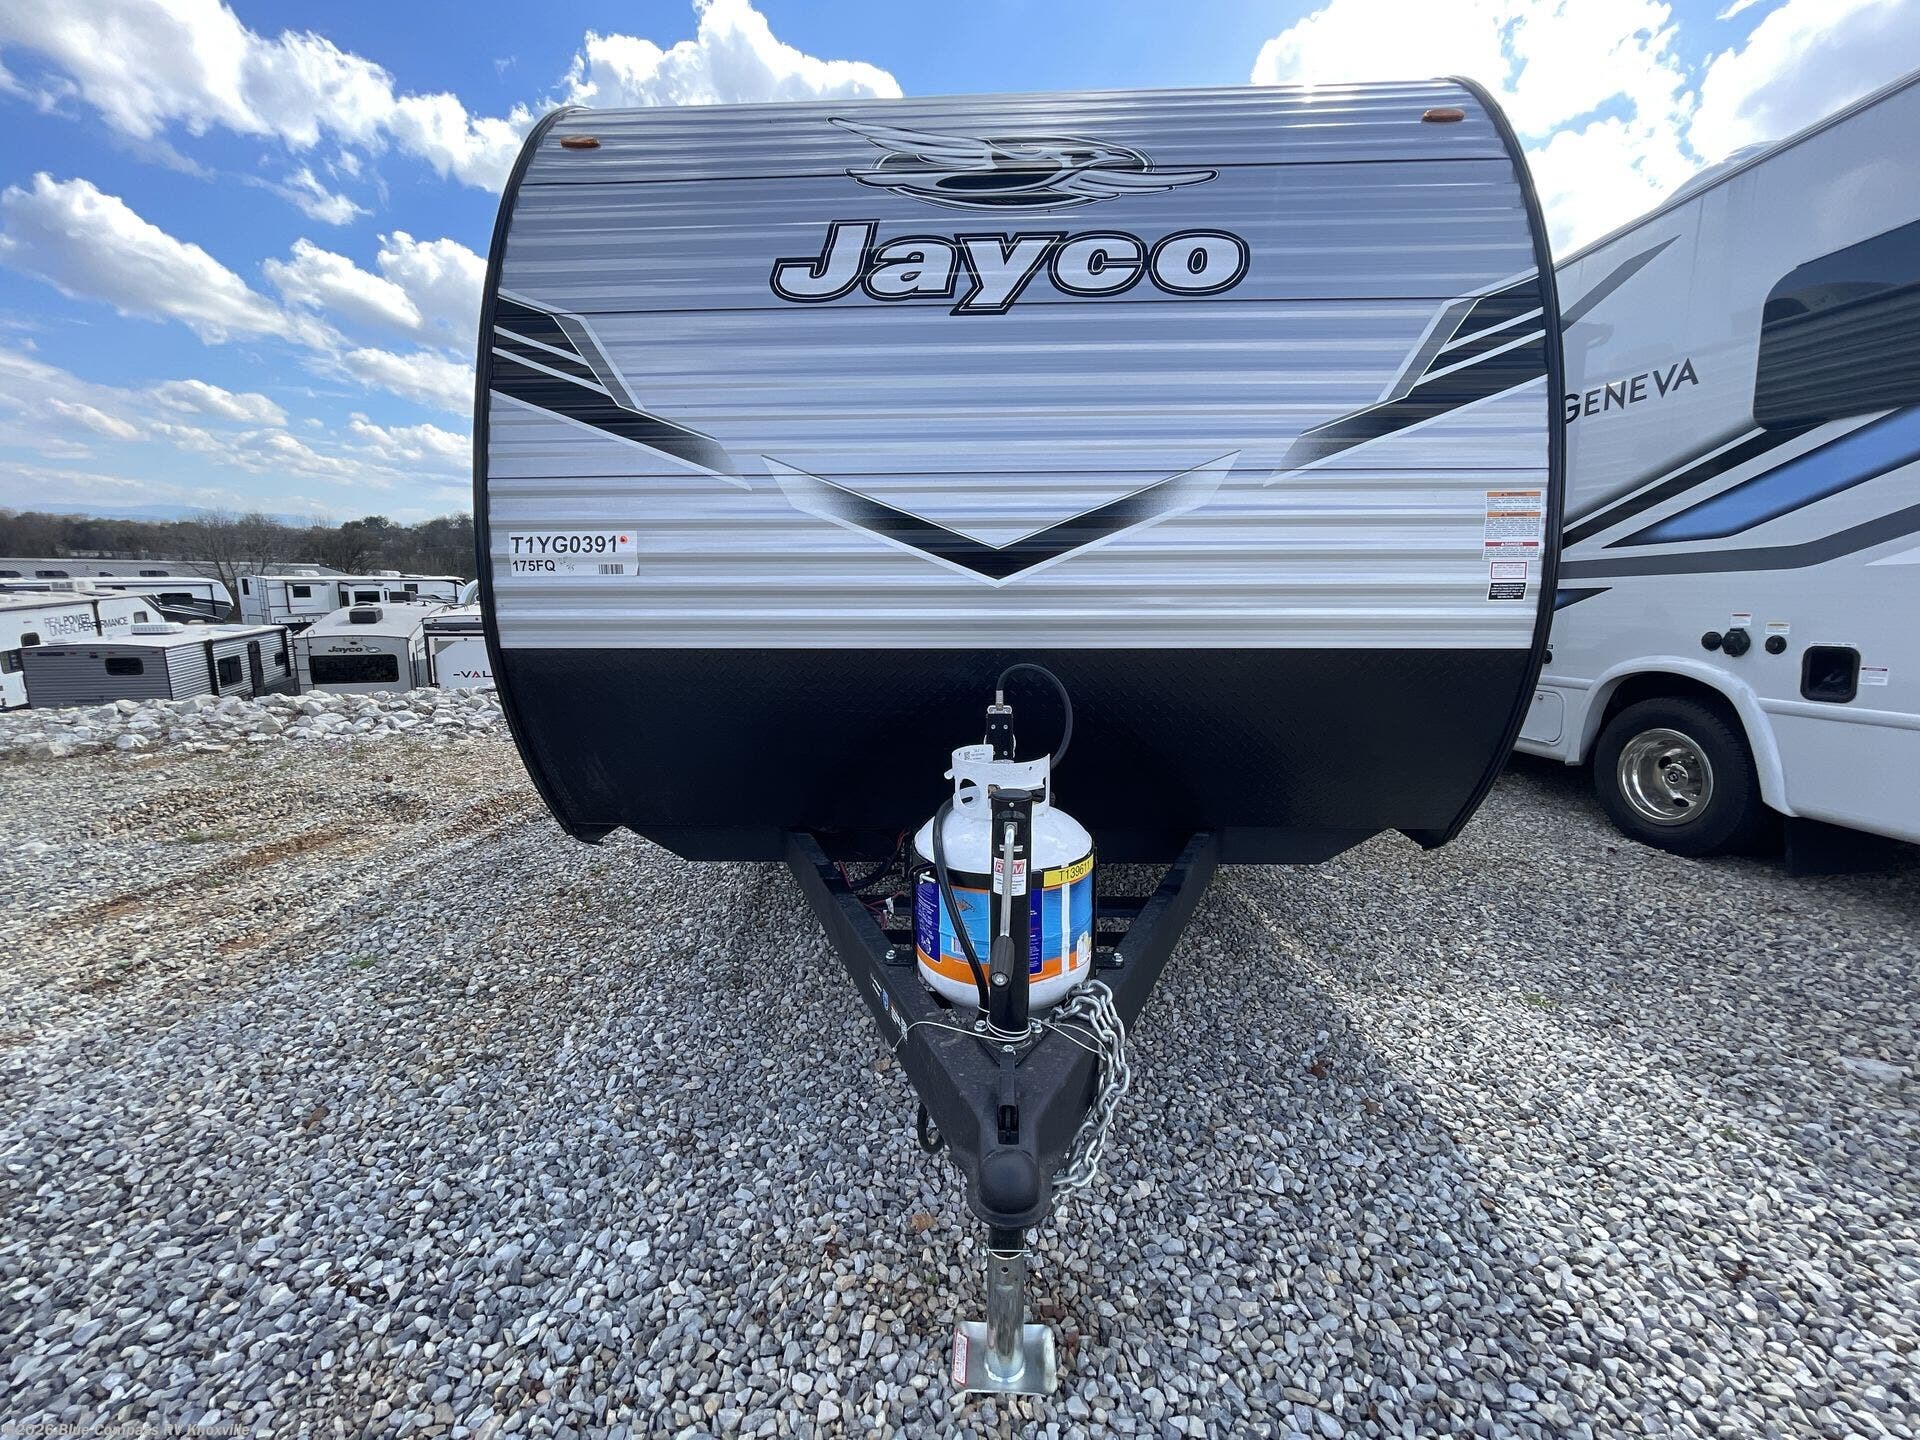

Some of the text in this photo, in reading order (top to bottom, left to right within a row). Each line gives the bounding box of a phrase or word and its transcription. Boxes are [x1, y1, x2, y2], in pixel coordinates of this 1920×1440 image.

[770, 219, 1250, 316] Jayco
[1564, 357, 1699, 424] GENEVA
[510, 535, 617, 553] T1YG0391
[512, 559, 556, 572] 175FQ
